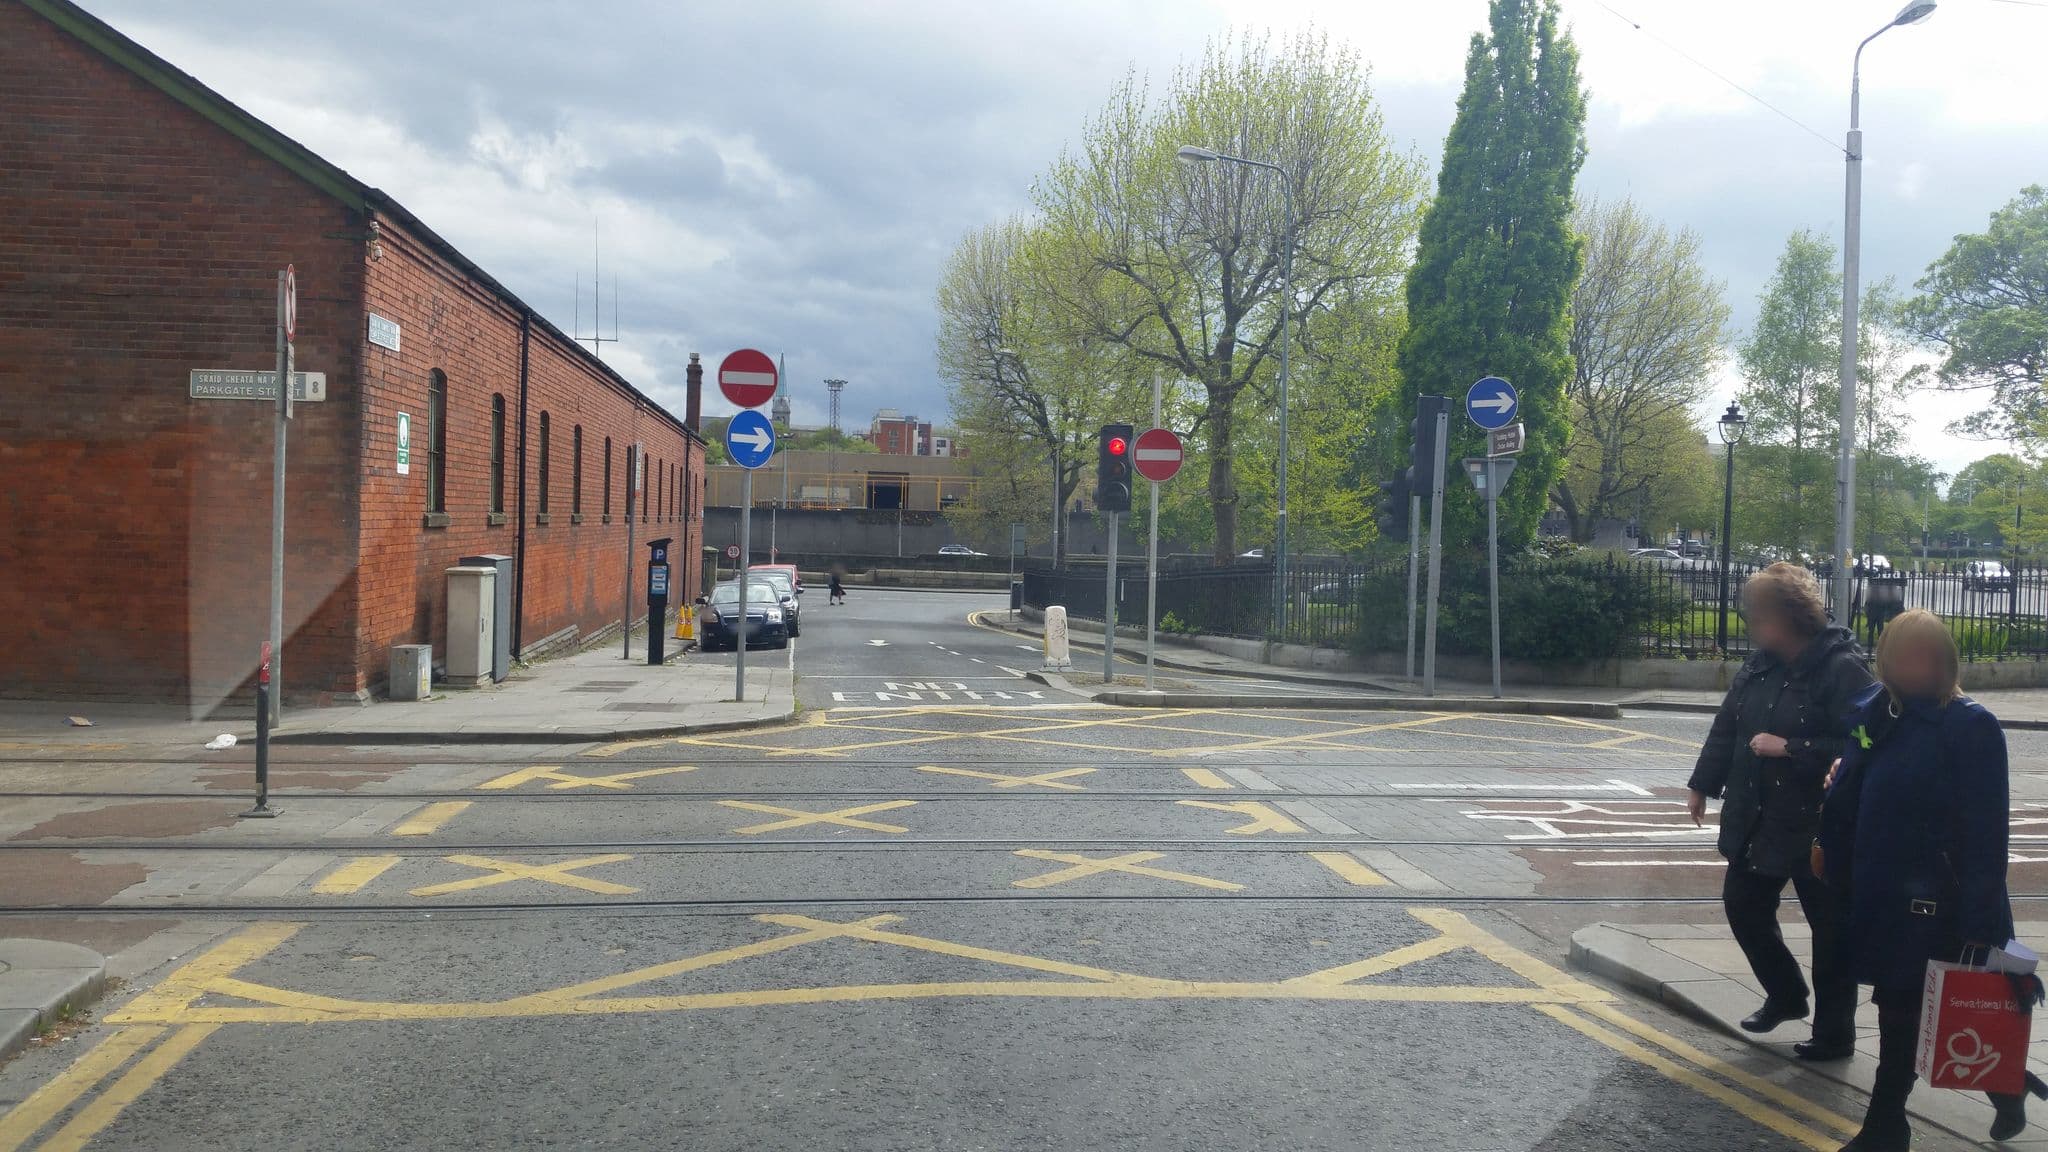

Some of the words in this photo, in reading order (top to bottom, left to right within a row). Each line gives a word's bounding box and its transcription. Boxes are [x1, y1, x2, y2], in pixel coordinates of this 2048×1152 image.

[257, 375, 267, 385] NA
[196, 385, 254, 396] PARKGATE
[311, 381, 319, 394] 8
[656, 549, 664, 560] P
[884, 681, 968, 690] NO
[831, 691, 1046, 701] ENTRY
